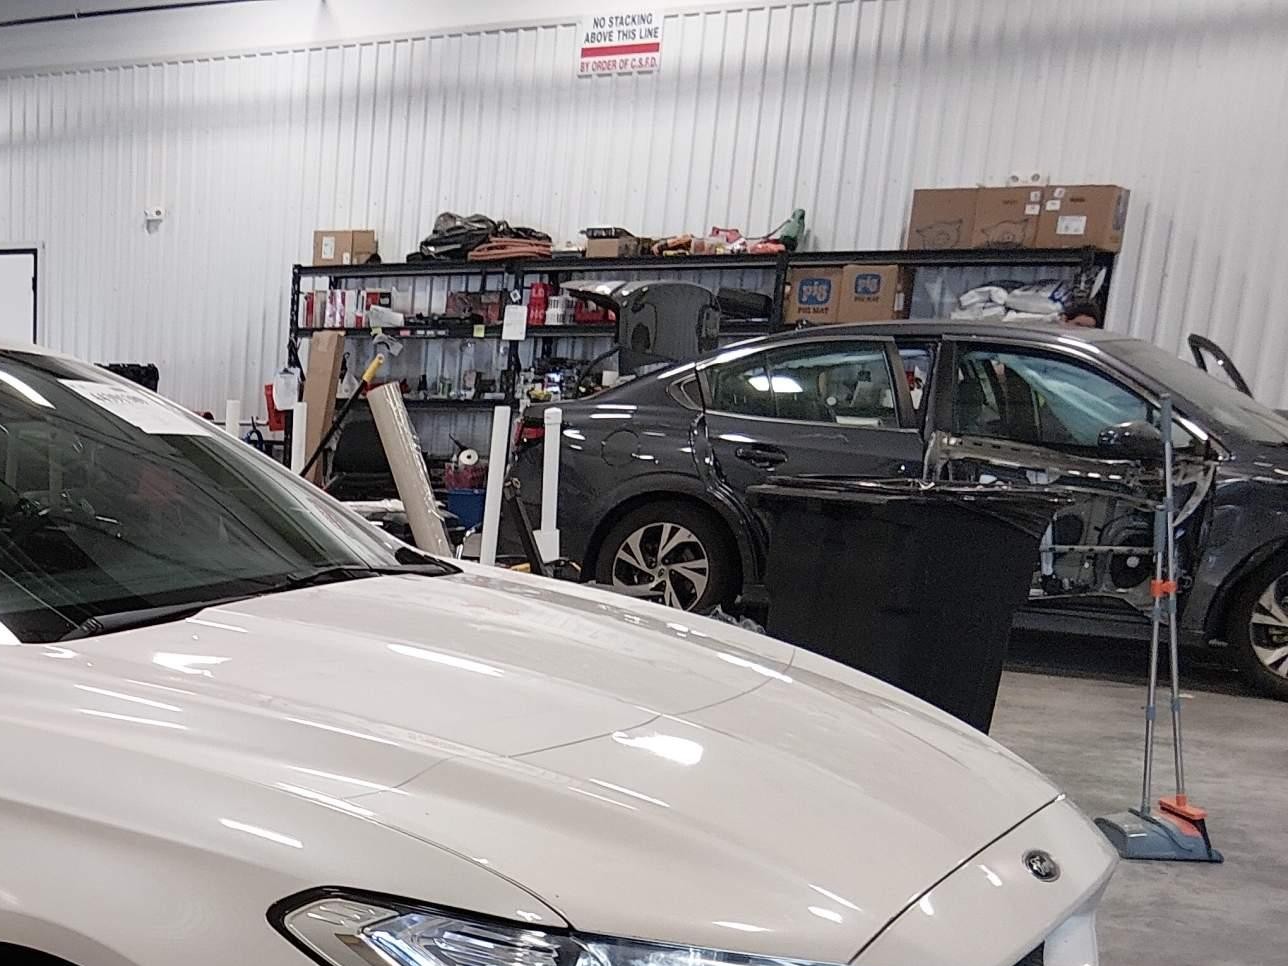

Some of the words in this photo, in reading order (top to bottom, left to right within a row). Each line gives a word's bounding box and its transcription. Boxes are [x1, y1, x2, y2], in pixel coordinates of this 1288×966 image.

[593, 17, 605, 29] NO
[608, 13, 653, 28] STACKING
[584, 31, 614, 44] ABOVE
[617, 29, 637, 41] THIS
[639, 27, 660, 39] LINE
[580, 62, 591, 73] BY
[592, 59, 617, 72] ORDER
[619, 58, 630, 70] OF
